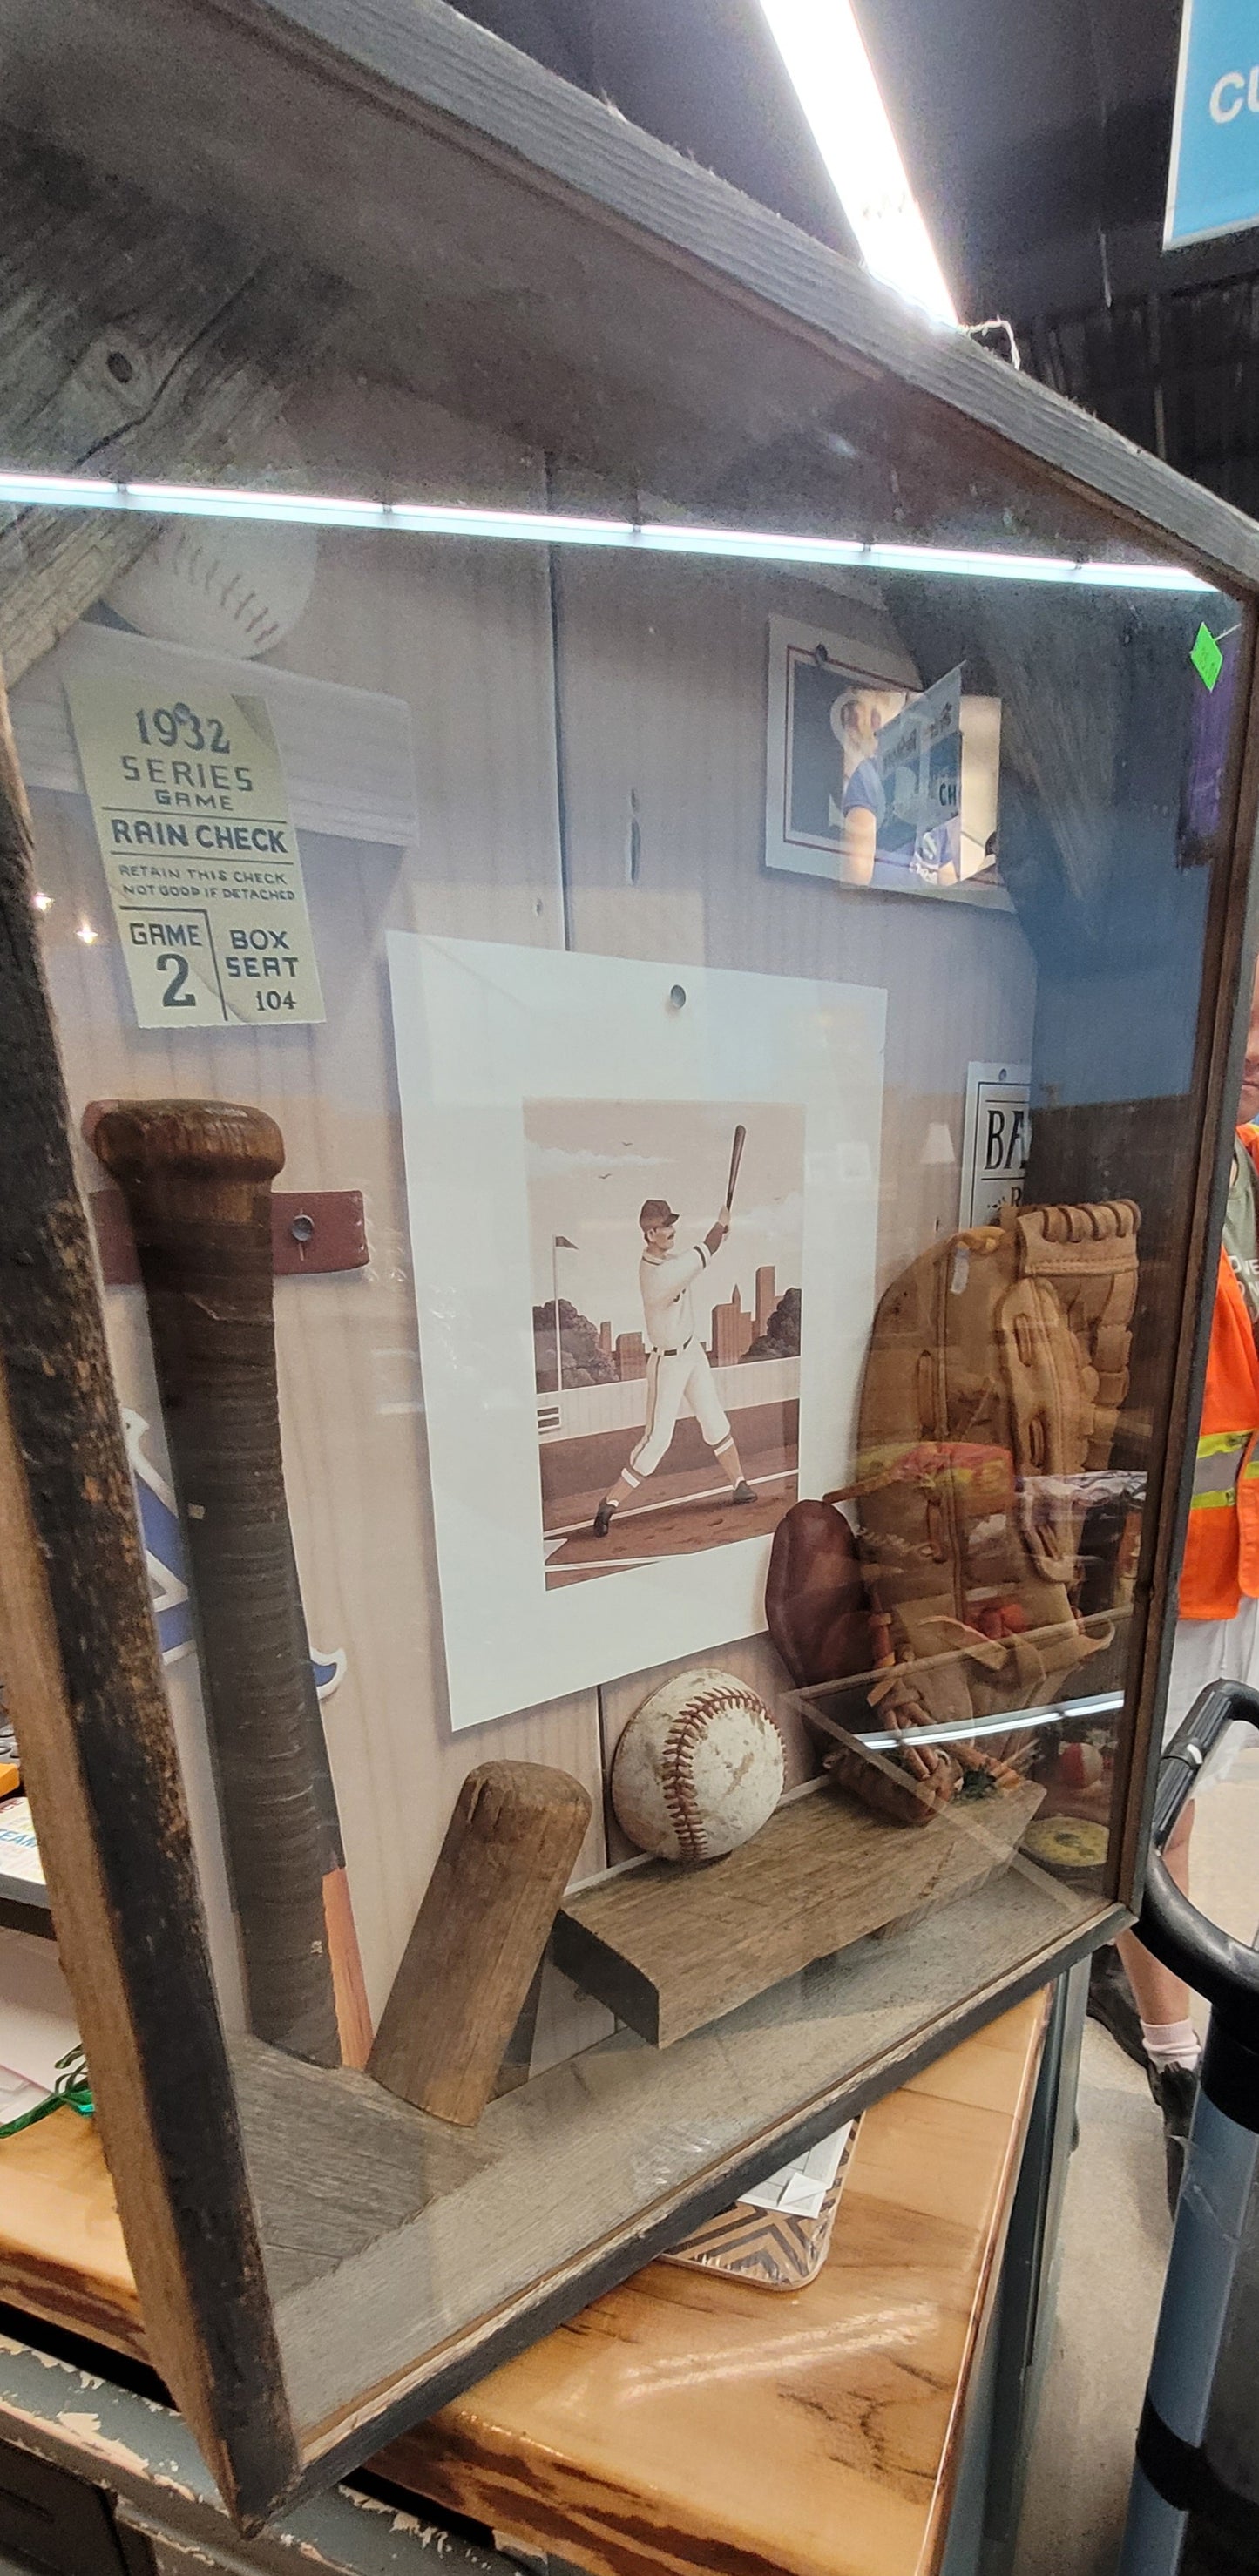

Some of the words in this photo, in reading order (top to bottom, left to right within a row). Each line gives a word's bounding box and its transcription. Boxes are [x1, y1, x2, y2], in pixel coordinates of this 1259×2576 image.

[136, 707, 230, 754] 1932
[121, 755, 253, 792] SERIES
[155, 789, 234, 811] GAME
[112, 819, 189, 847] RAIN
[196, 824, 288, 854] CHECK
[118, 864, 180, 879] RETAIN
[187, 869, 227, 882] THIS
[234, 871, 288, 885] CHECK
[123, 884, 159, 896] NOT
[160, 885, 200, 897] GOOD
[205, 887, 218, 898] IF
[223, 889, 295, 901] DETACHED
[129, 923, 203, 947] GAME
[229, 929, 290, 950] BOX
[225, 957, 300, 978] SEAT
[156, 953, 197, 1008] 2
[255, 990, 297, 1011] 104
